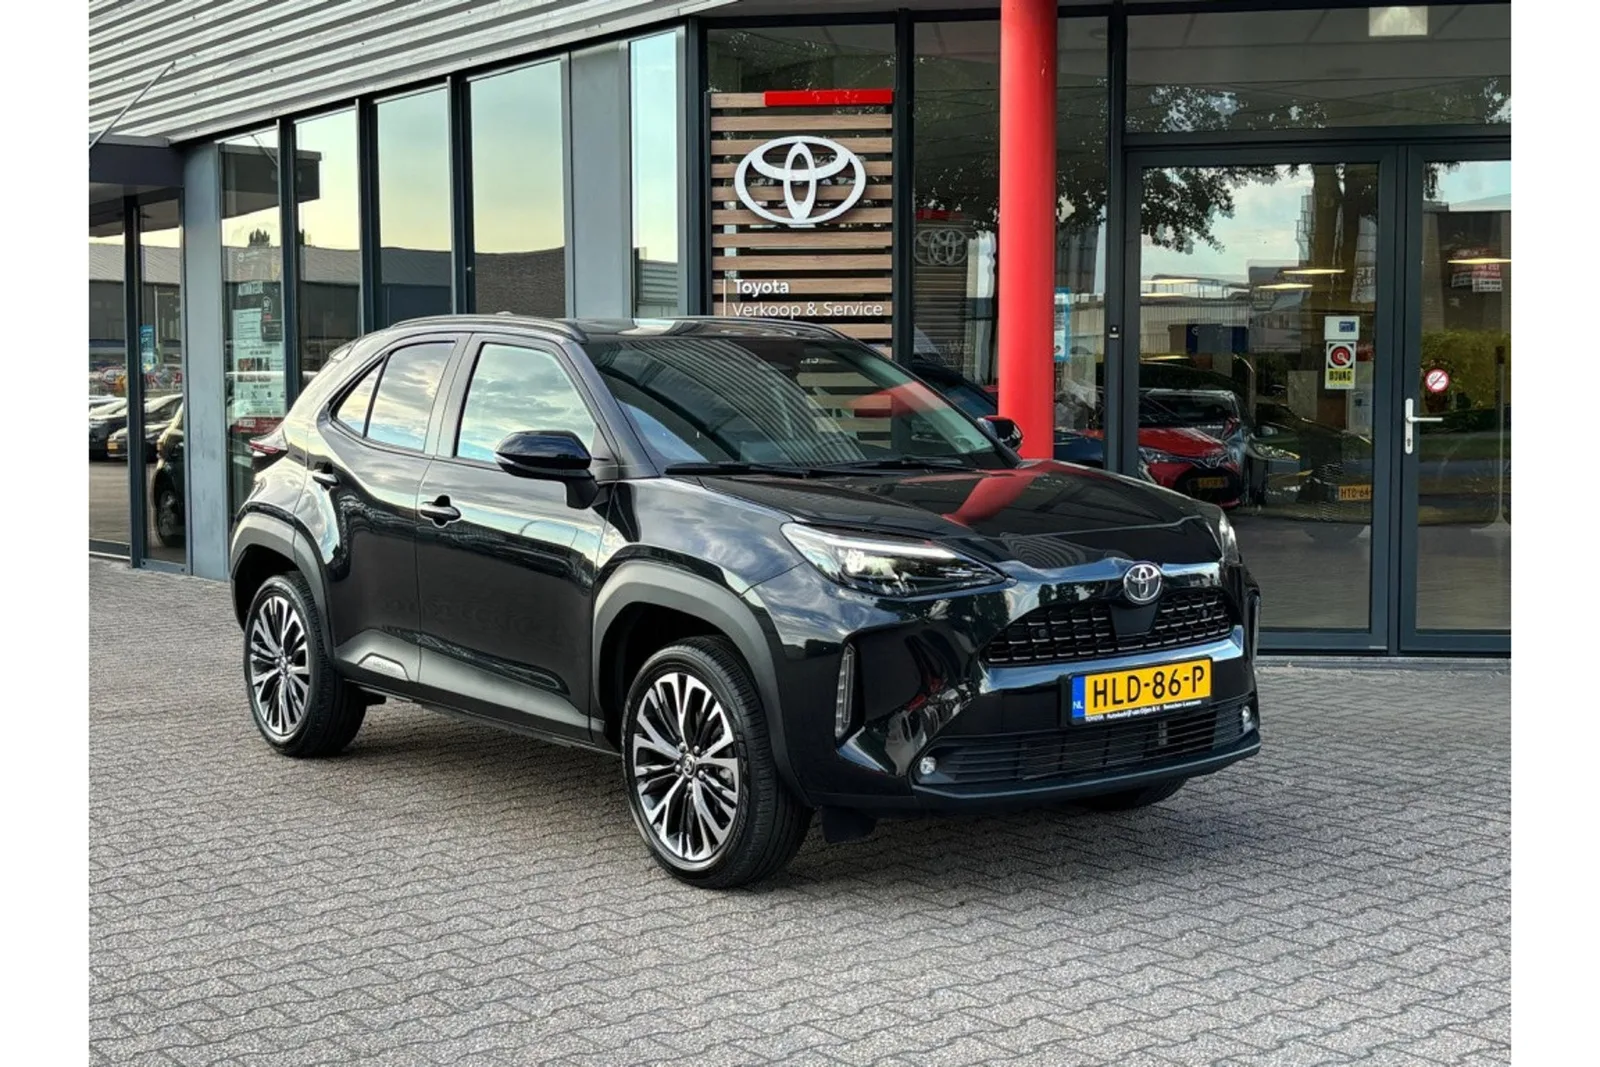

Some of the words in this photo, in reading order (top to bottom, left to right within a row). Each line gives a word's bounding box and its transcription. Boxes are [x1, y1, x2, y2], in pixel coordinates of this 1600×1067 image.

[733, 279, 790, 297] Toyota
[732, 302, 801, 320] Verkoop
[806, 302, 818, 316] &
[823, 302, 883, 316] Service
[1093, 665, 1205, 709] HLD-86-P
[1072, 701, 1084, 710] NL
